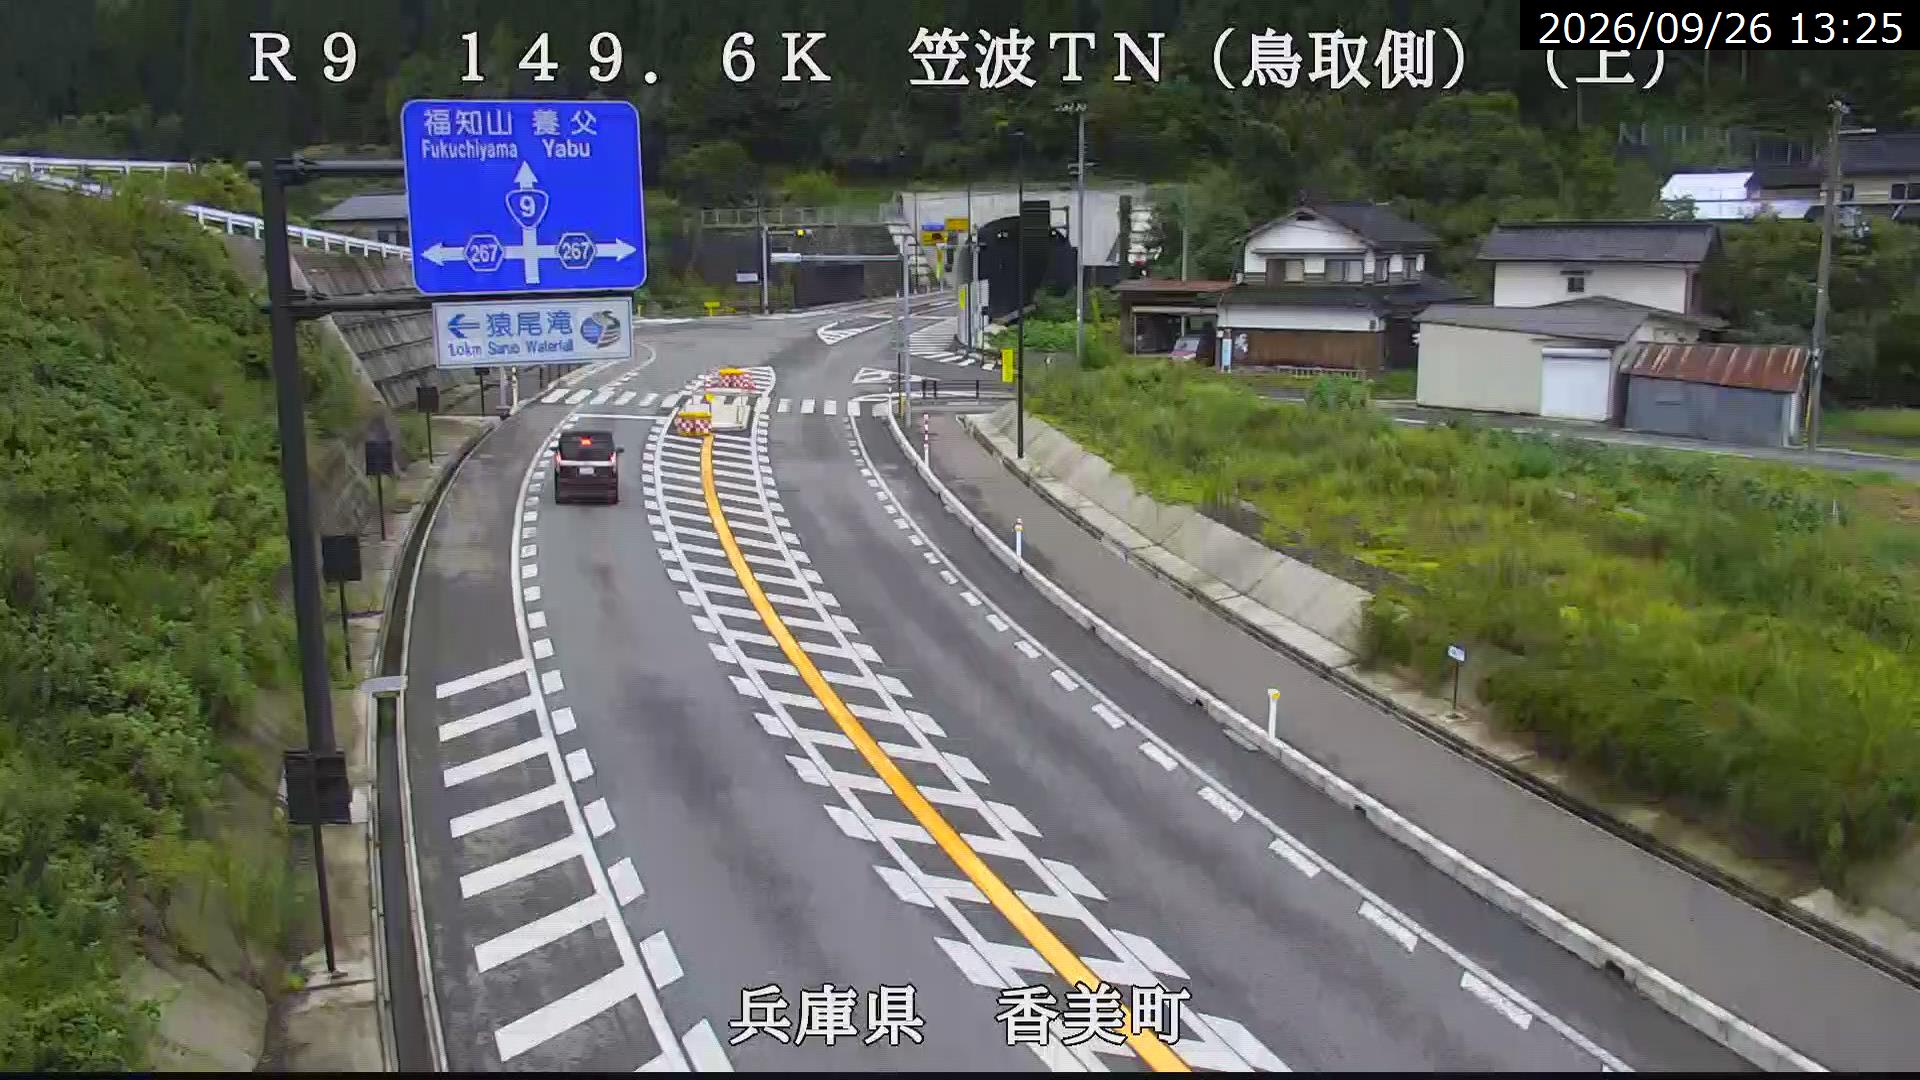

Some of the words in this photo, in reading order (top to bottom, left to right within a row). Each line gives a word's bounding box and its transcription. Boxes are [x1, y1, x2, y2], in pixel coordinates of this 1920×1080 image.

[424, 109, 512, 136] 福知山
[533, 109, 598, 136] 養父
[421, 139, 518, 160] Fukuchiyama
[542, 138, 591, 158] Yabu
[518, 196, 536, 218] 9
[470, 244, 498, 262] 267
[561, 241, 591, 260] 267
[486, 310, 574, 338] 猿尾滝
